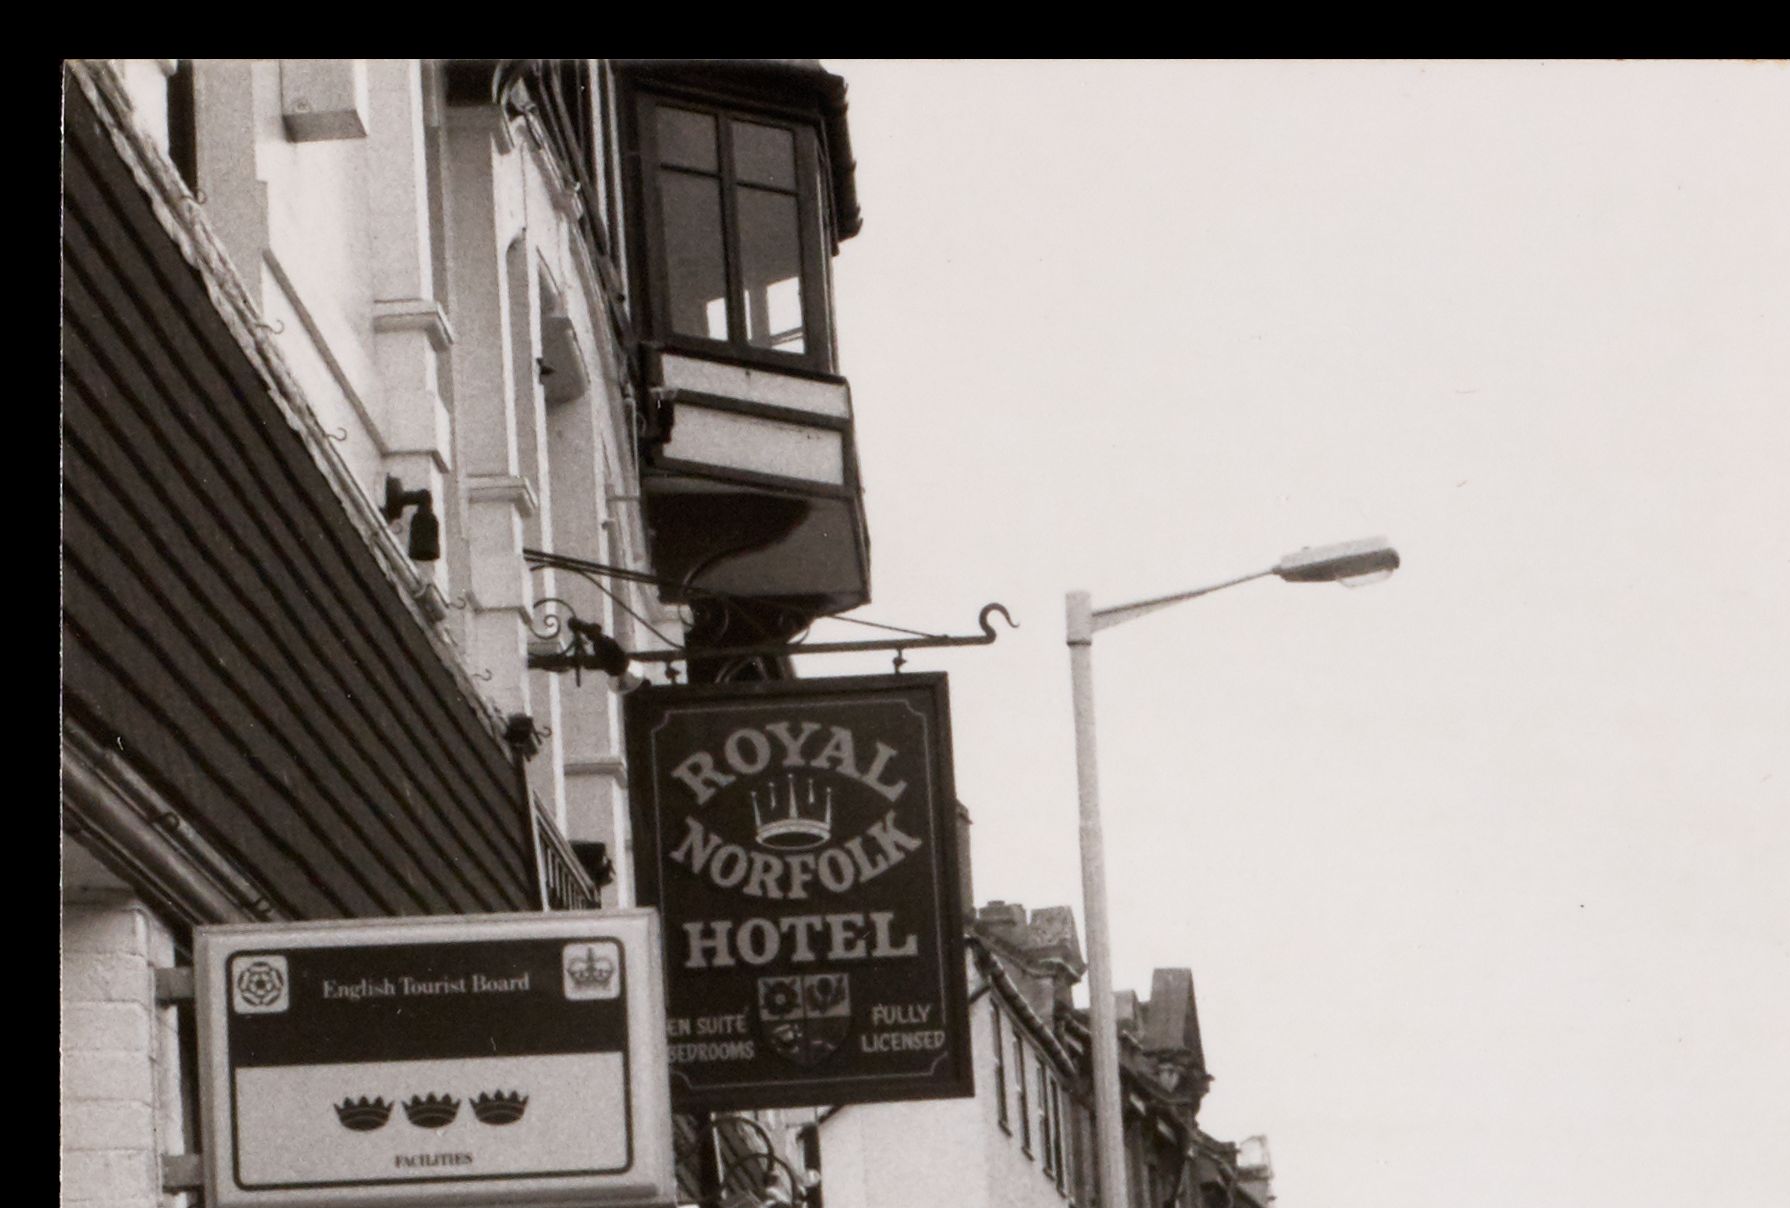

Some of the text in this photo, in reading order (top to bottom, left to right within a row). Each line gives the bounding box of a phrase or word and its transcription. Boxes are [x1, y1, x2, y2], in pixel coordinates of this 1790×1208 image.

[670, 721, 908, 805] ROYAL
[669, 809, 923, 900] NORFOLK
[682, 911, 919, 969] HOTEL
[322, 971, 531, 1000] English Tourist Board
[667, 1013, 748, 1037] EN SUITE
[873, 1003, 933, 1027] FULLY
[668, 1040, 756, 1064] BEDROOMS
[862, 1030, 946, 1053] LICENSED
[394, 1152, 475, 1169] FACILITIES
